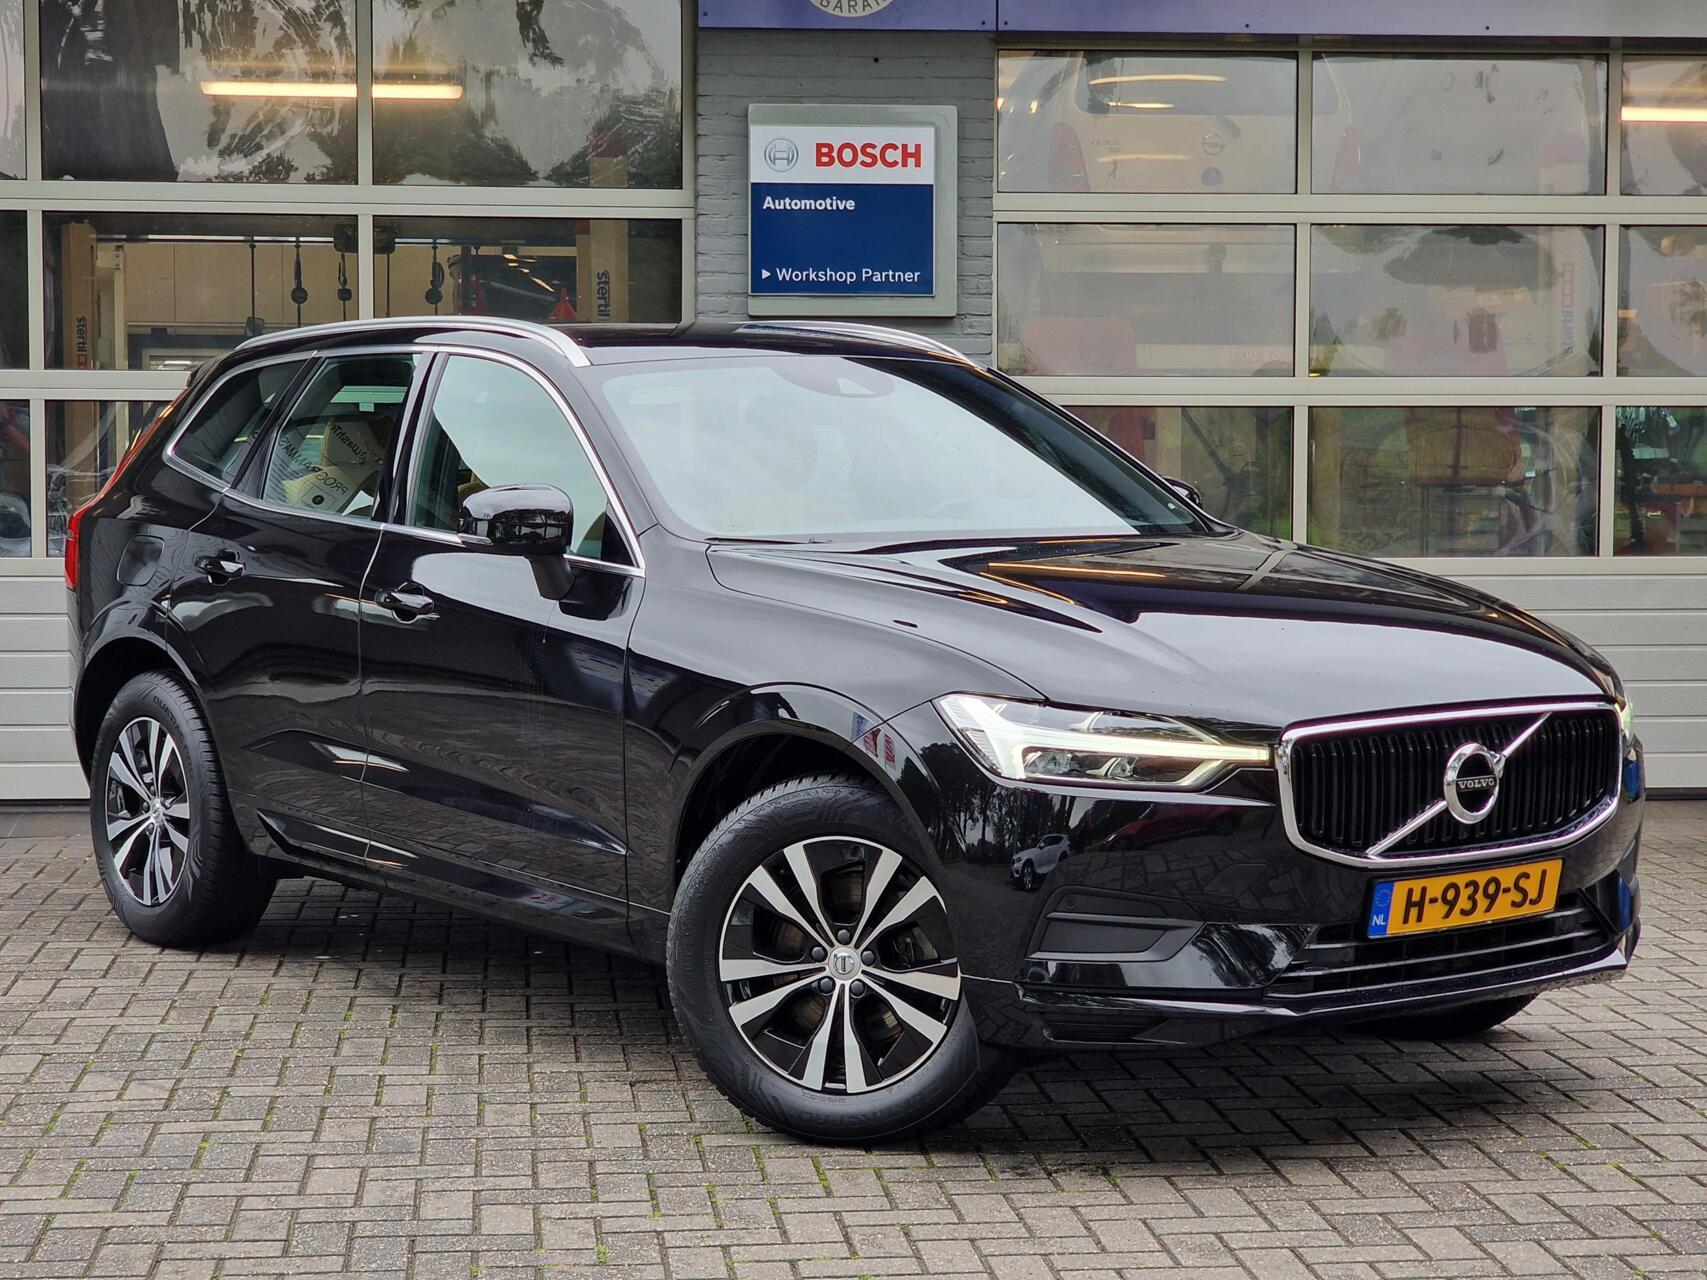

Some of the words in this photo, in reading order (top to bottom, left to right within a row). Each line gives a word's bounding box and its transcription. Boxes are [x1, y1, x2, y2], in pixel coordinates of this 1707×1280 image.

[815, 142, 922, 168] BOSCH
[762, 196, 856, 211] Automotive
[776, 268, 857, 284] Workshop
[861, 268, 921, 283] Partner
[596, 270, 610, 317] stertil
[76, 316, 88, 352] stertil
[1457, 778, 1495, 789] VOLVO
[1402, 868, 1548, 925] H-939-SJ
[1372, 916, 1386, 926] NL
